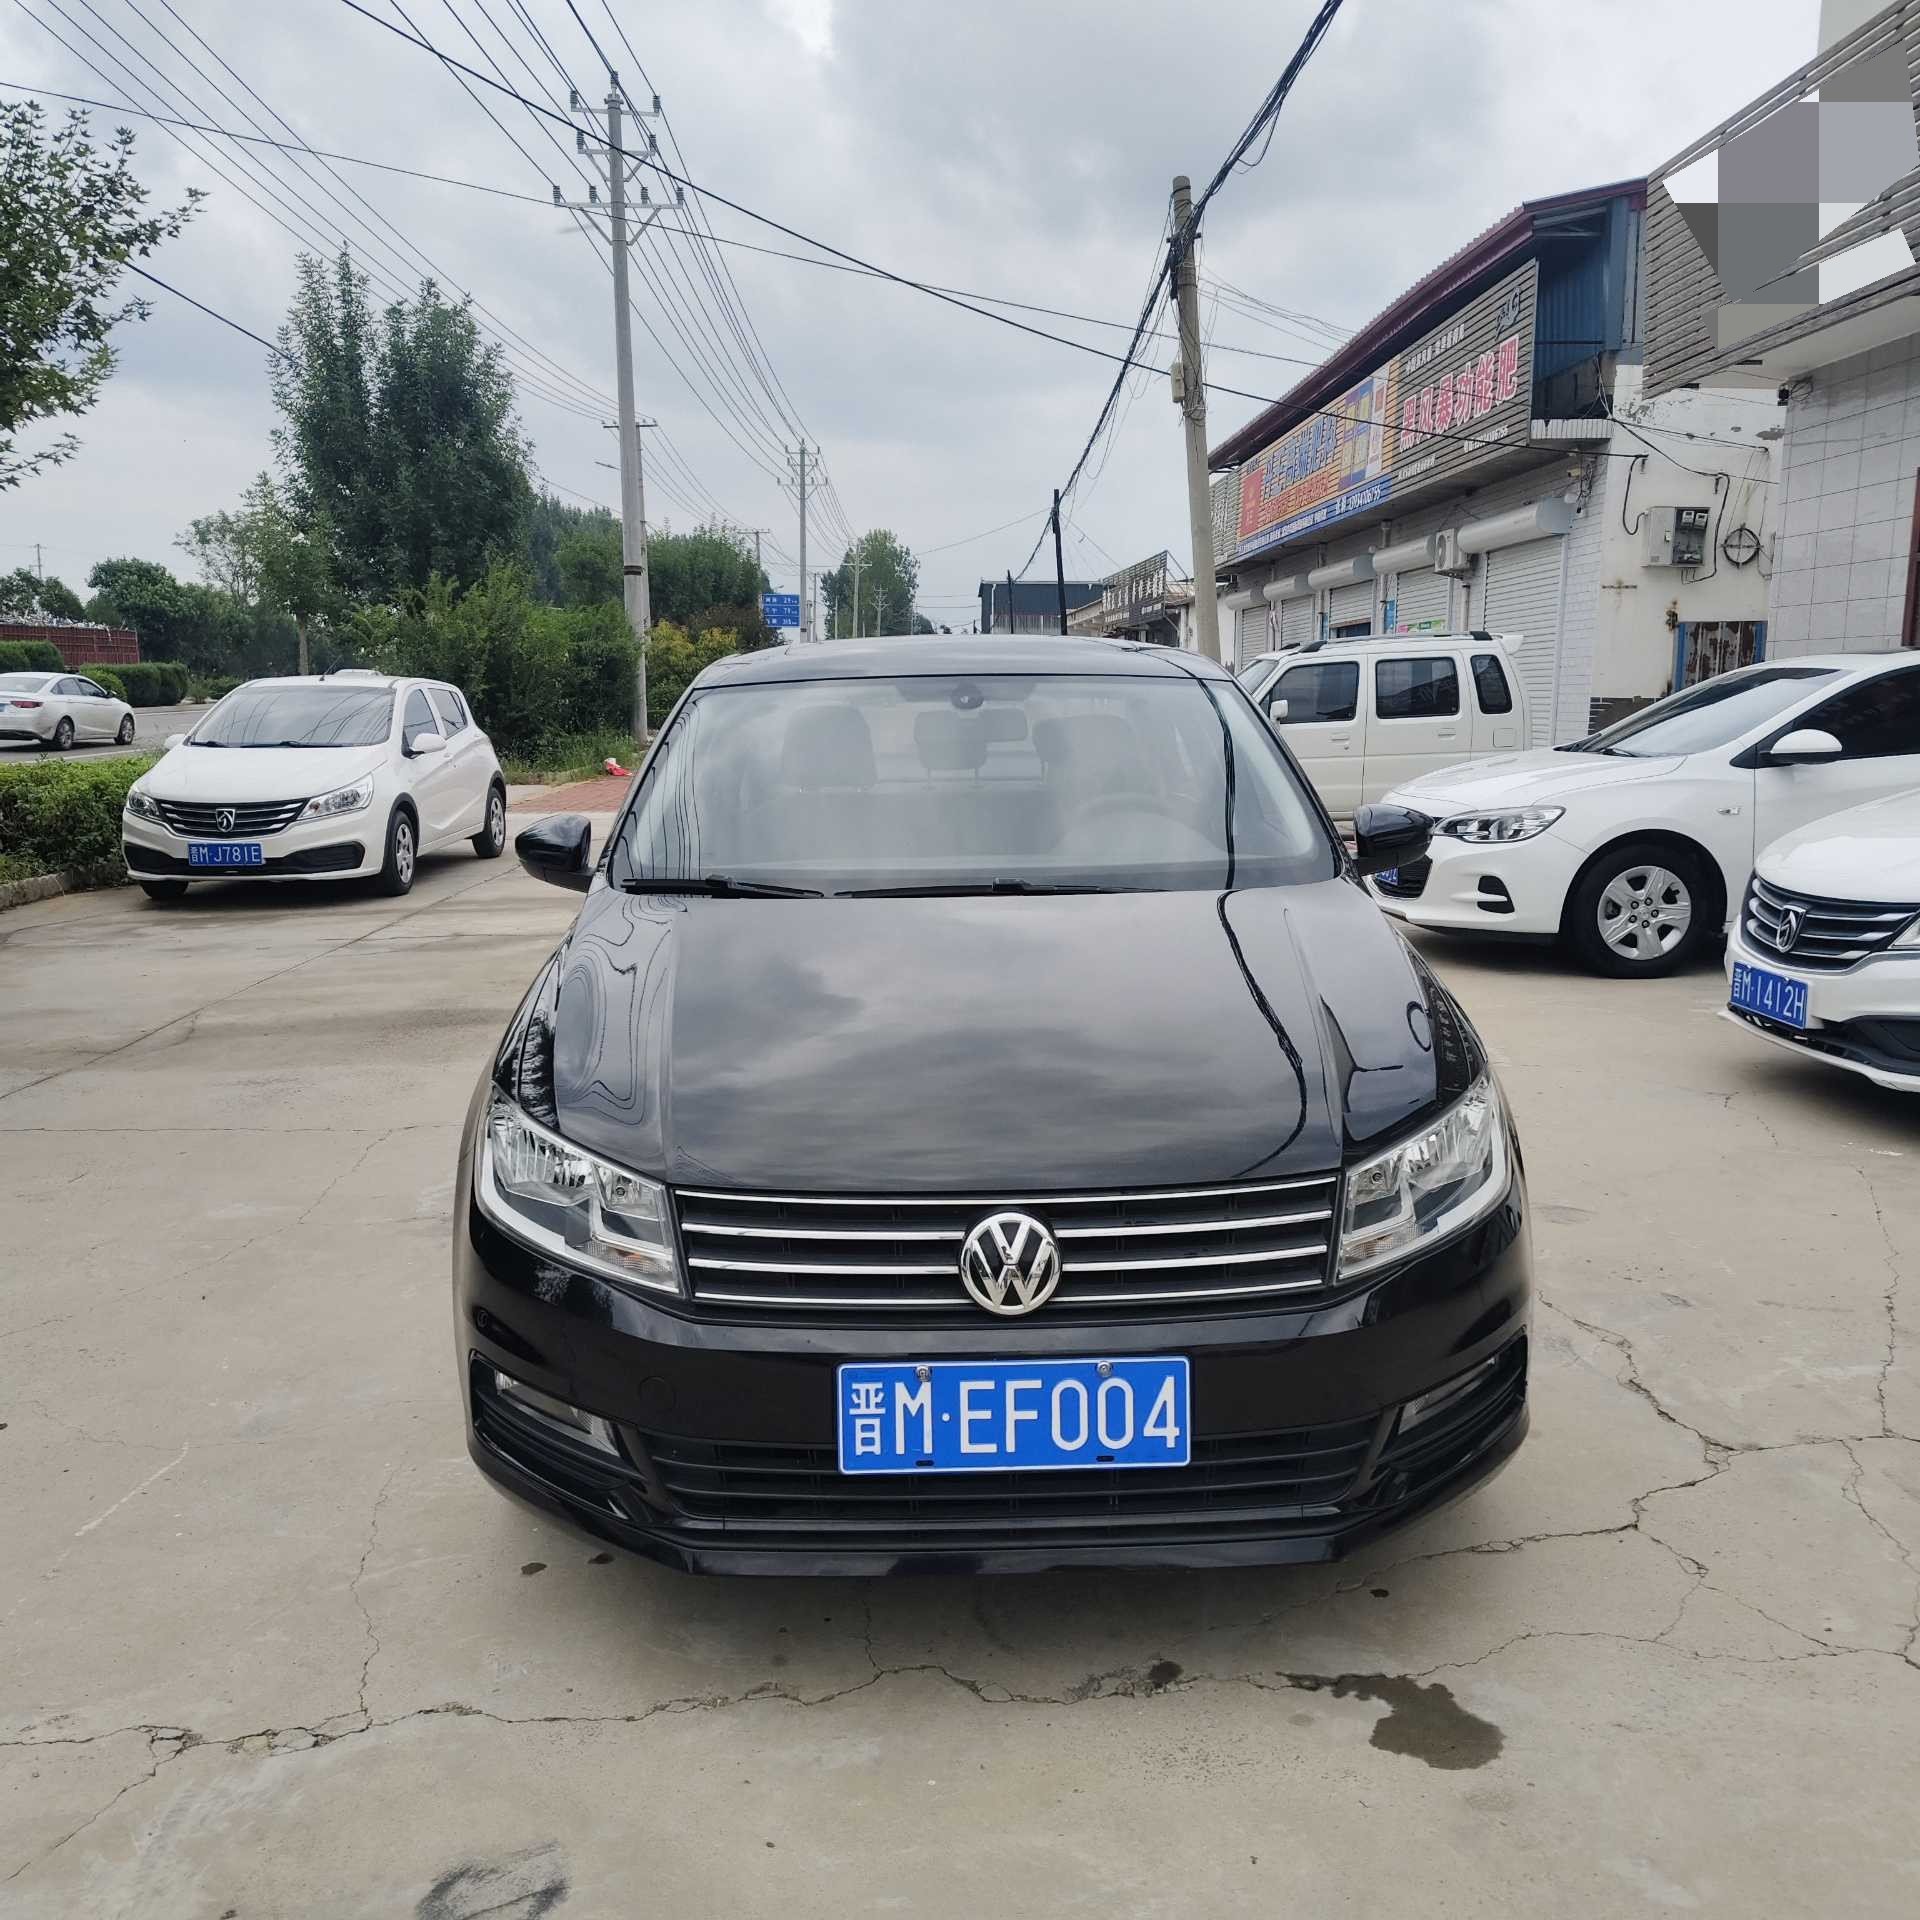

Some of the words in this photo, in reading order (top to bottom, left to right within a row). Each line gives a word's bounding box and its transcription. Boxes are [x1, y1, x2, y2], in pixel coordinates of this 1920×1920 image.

[1399, 333, 1520, 453] 黑风暴功能肥
